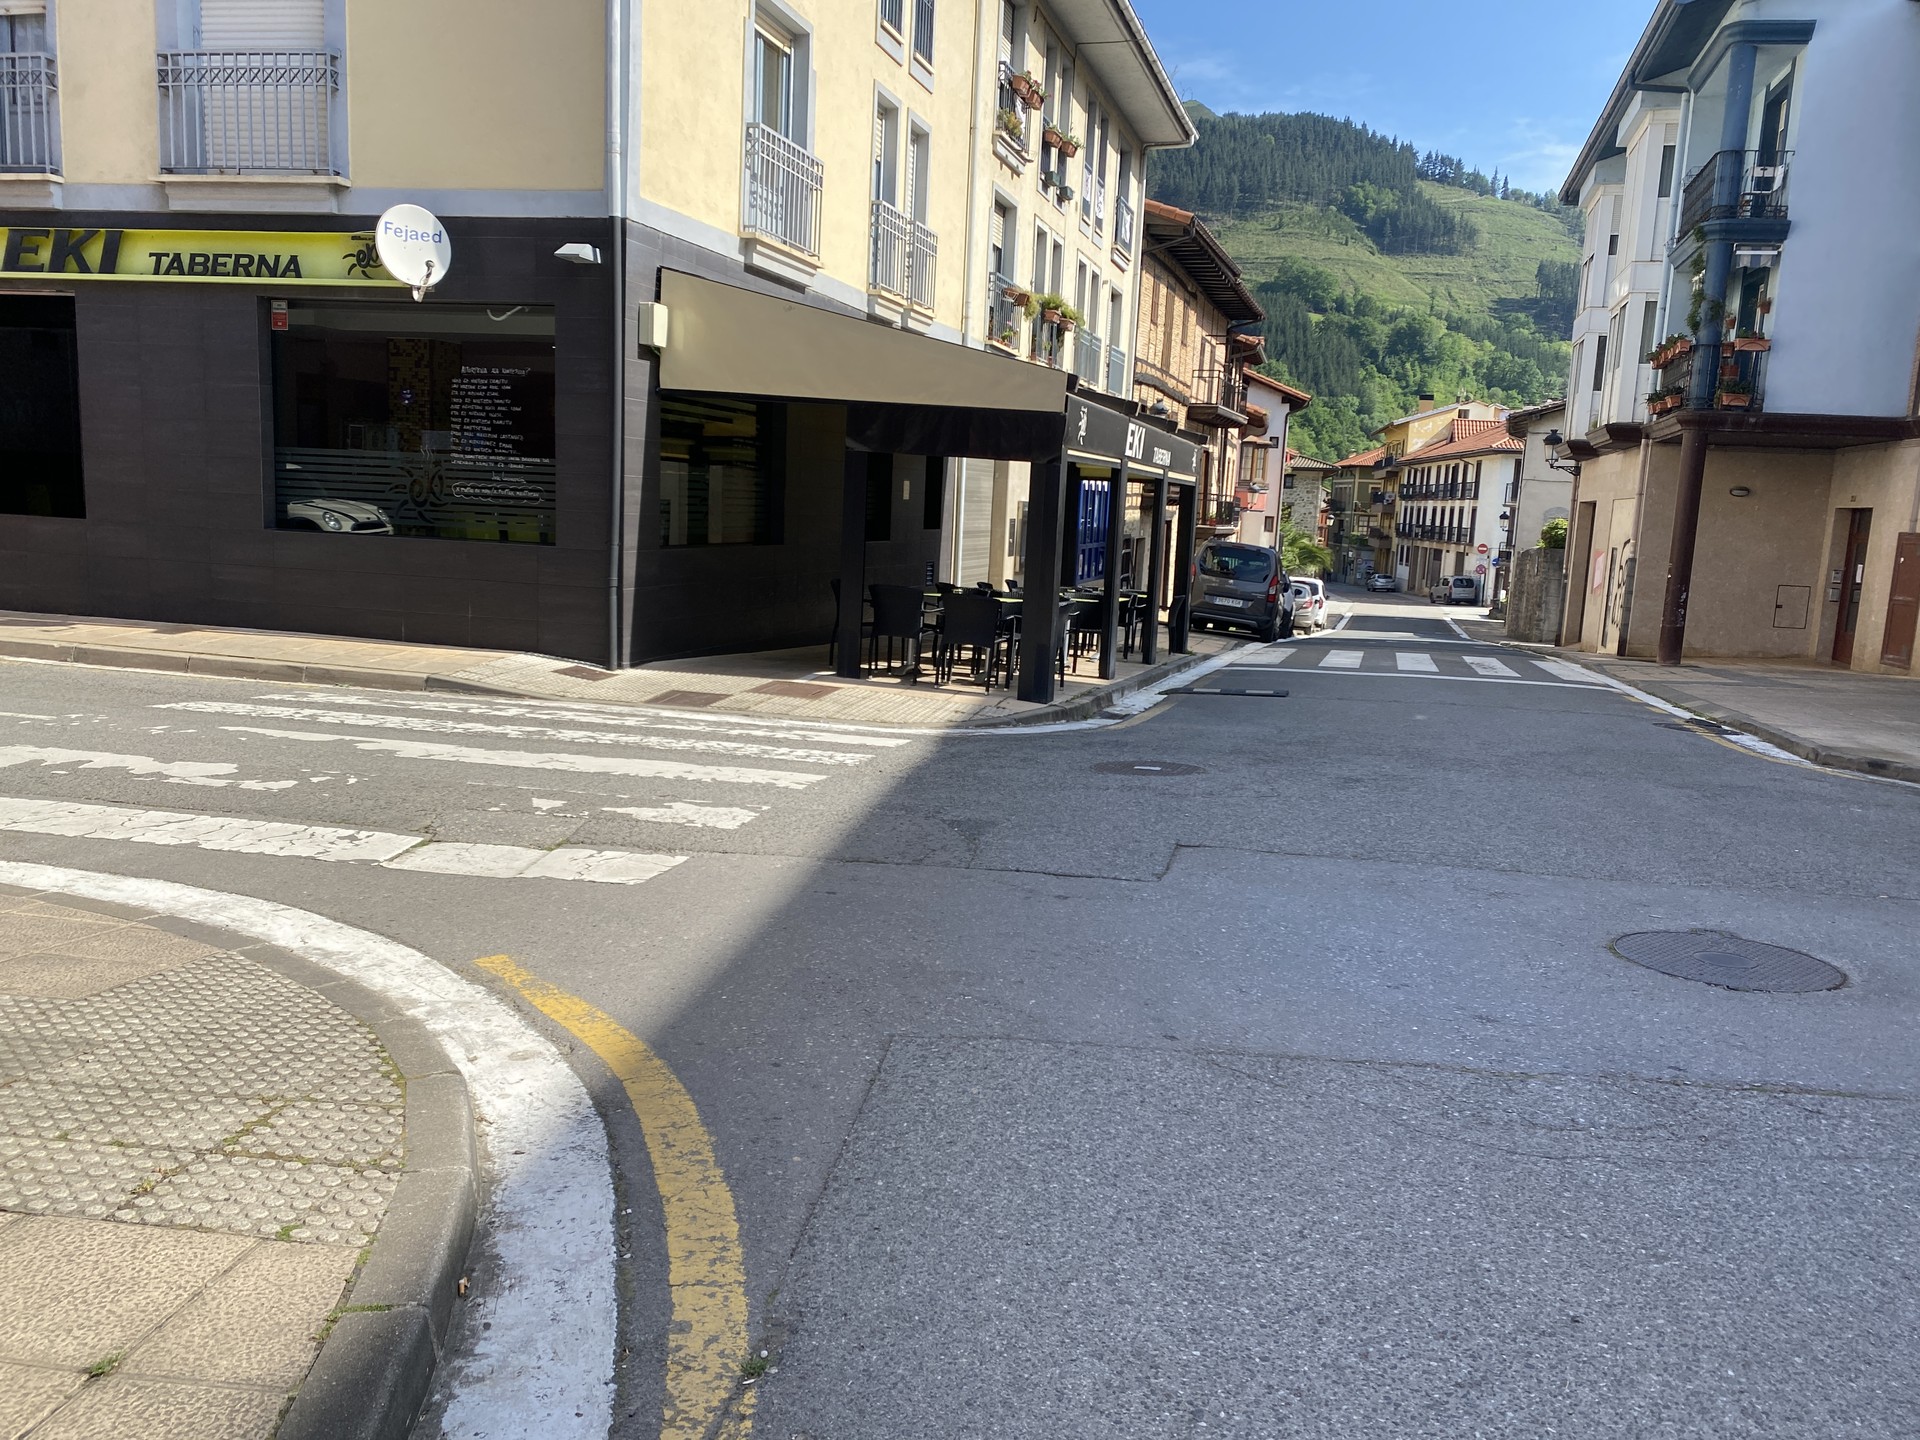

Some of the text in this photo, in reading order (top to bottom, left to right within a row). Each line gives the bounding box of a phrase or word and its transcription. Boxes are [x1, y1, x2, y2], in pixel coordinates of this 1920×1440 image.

[384, 221, 442, 243] Fejaed
[2, 229, 302, 278] EKI TABERNA
[1124, 422, 1146, 459] EKI
